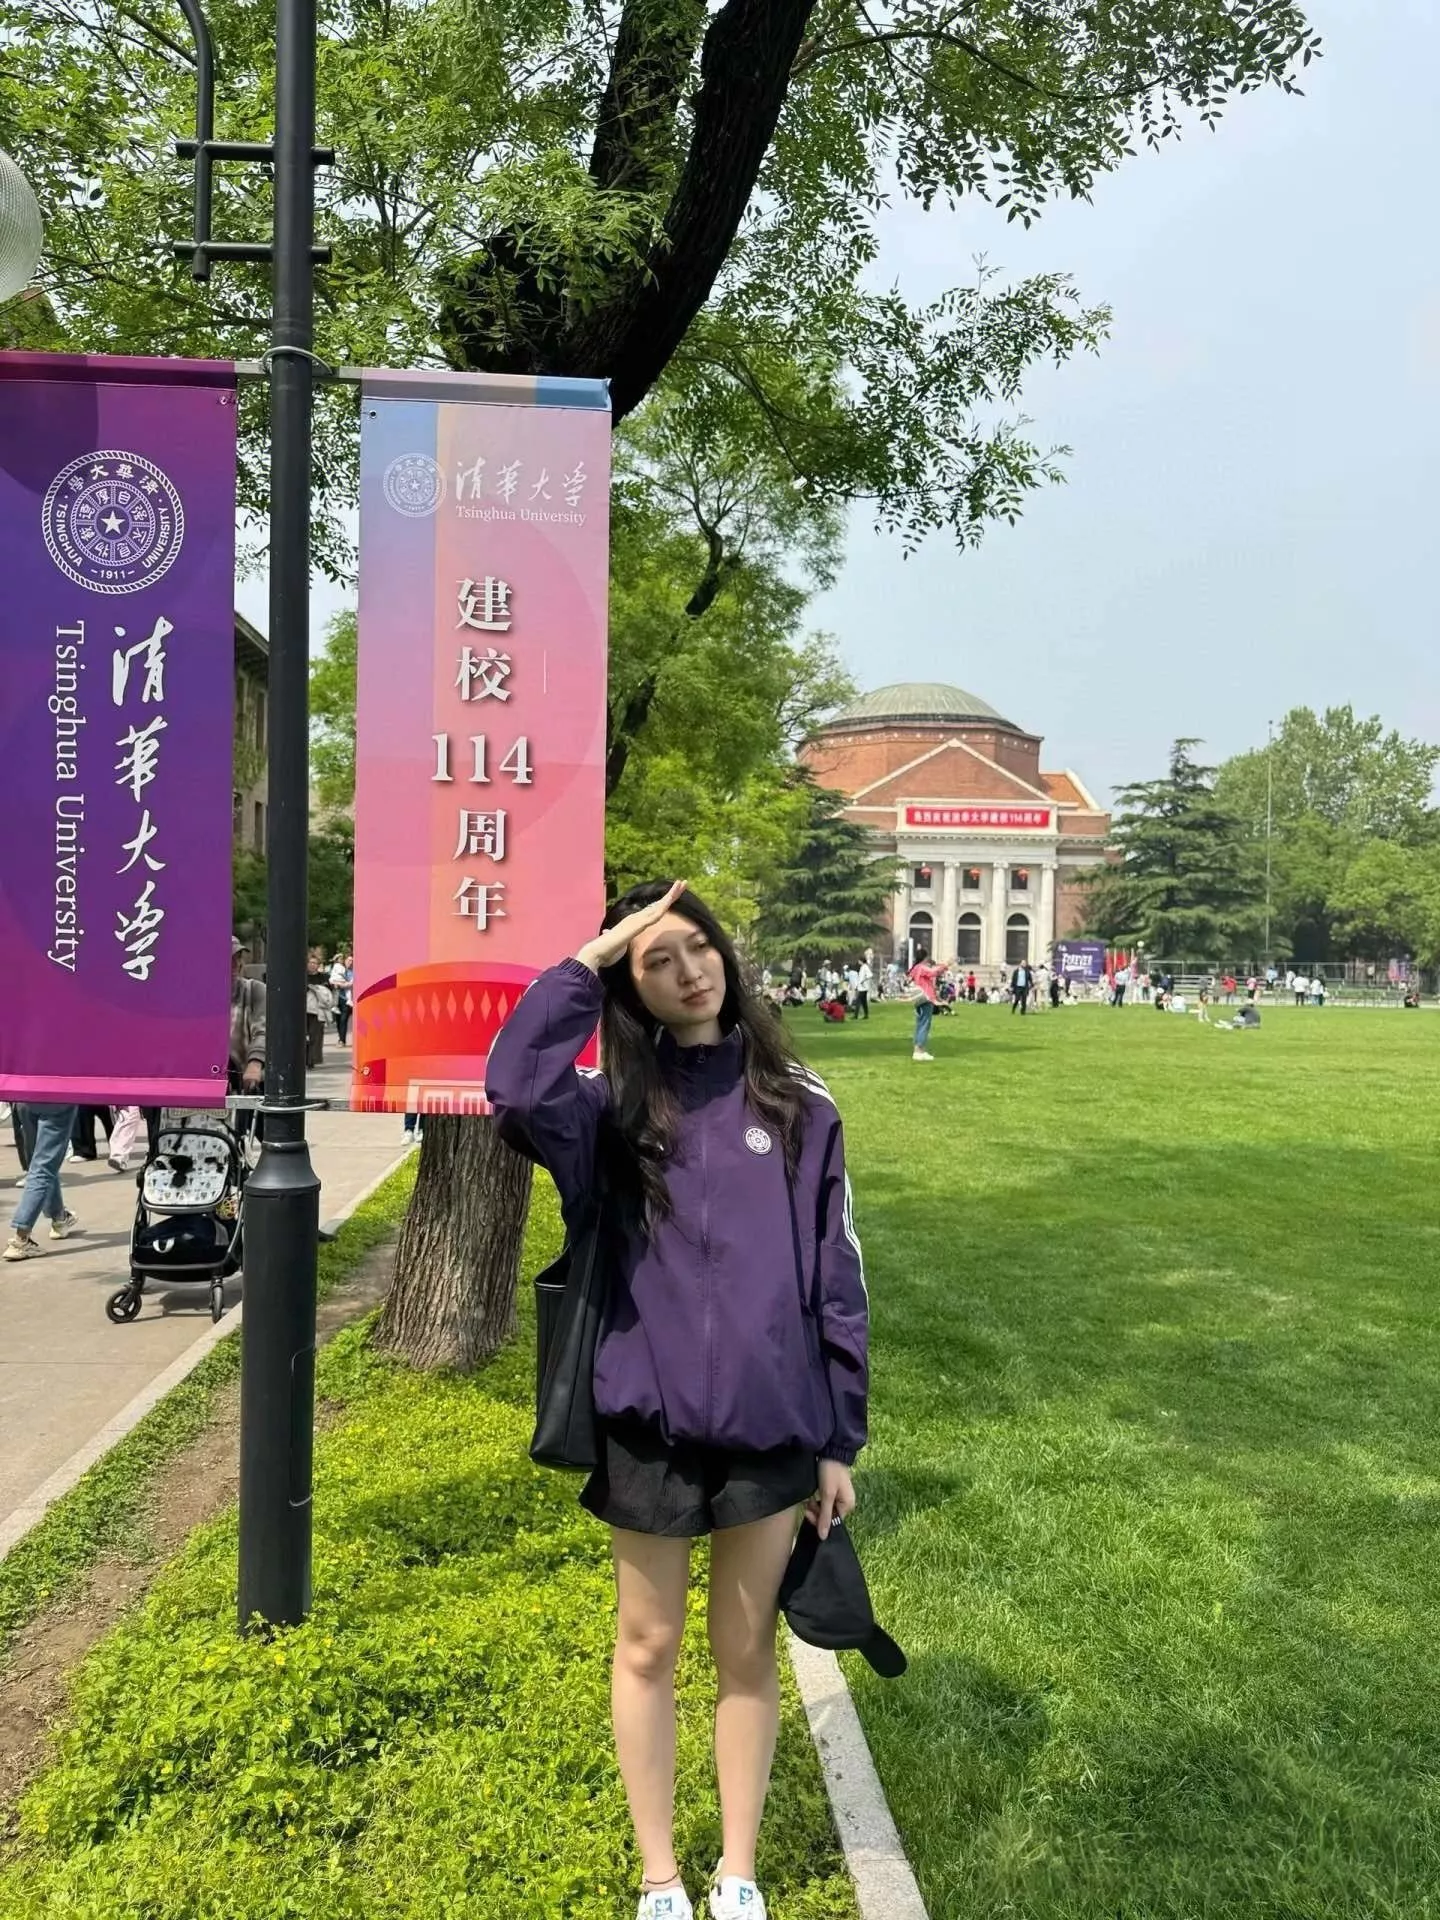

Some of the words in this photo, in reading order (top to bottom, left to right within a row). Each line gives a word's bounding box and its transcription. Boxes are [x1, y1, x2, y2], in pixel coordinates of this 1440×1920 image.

[56, 503, 83, 567] TSINGHUA
[142, 507, 171, 568] UNIVERSITY
[455, 505, 516, 522] Tsinghua
[520, 508, 587, 526] University
[99, 569, 127, 580] 1911
[48, 620, 86, 781] Tsinghua
[47, 794, 85, 972] University
